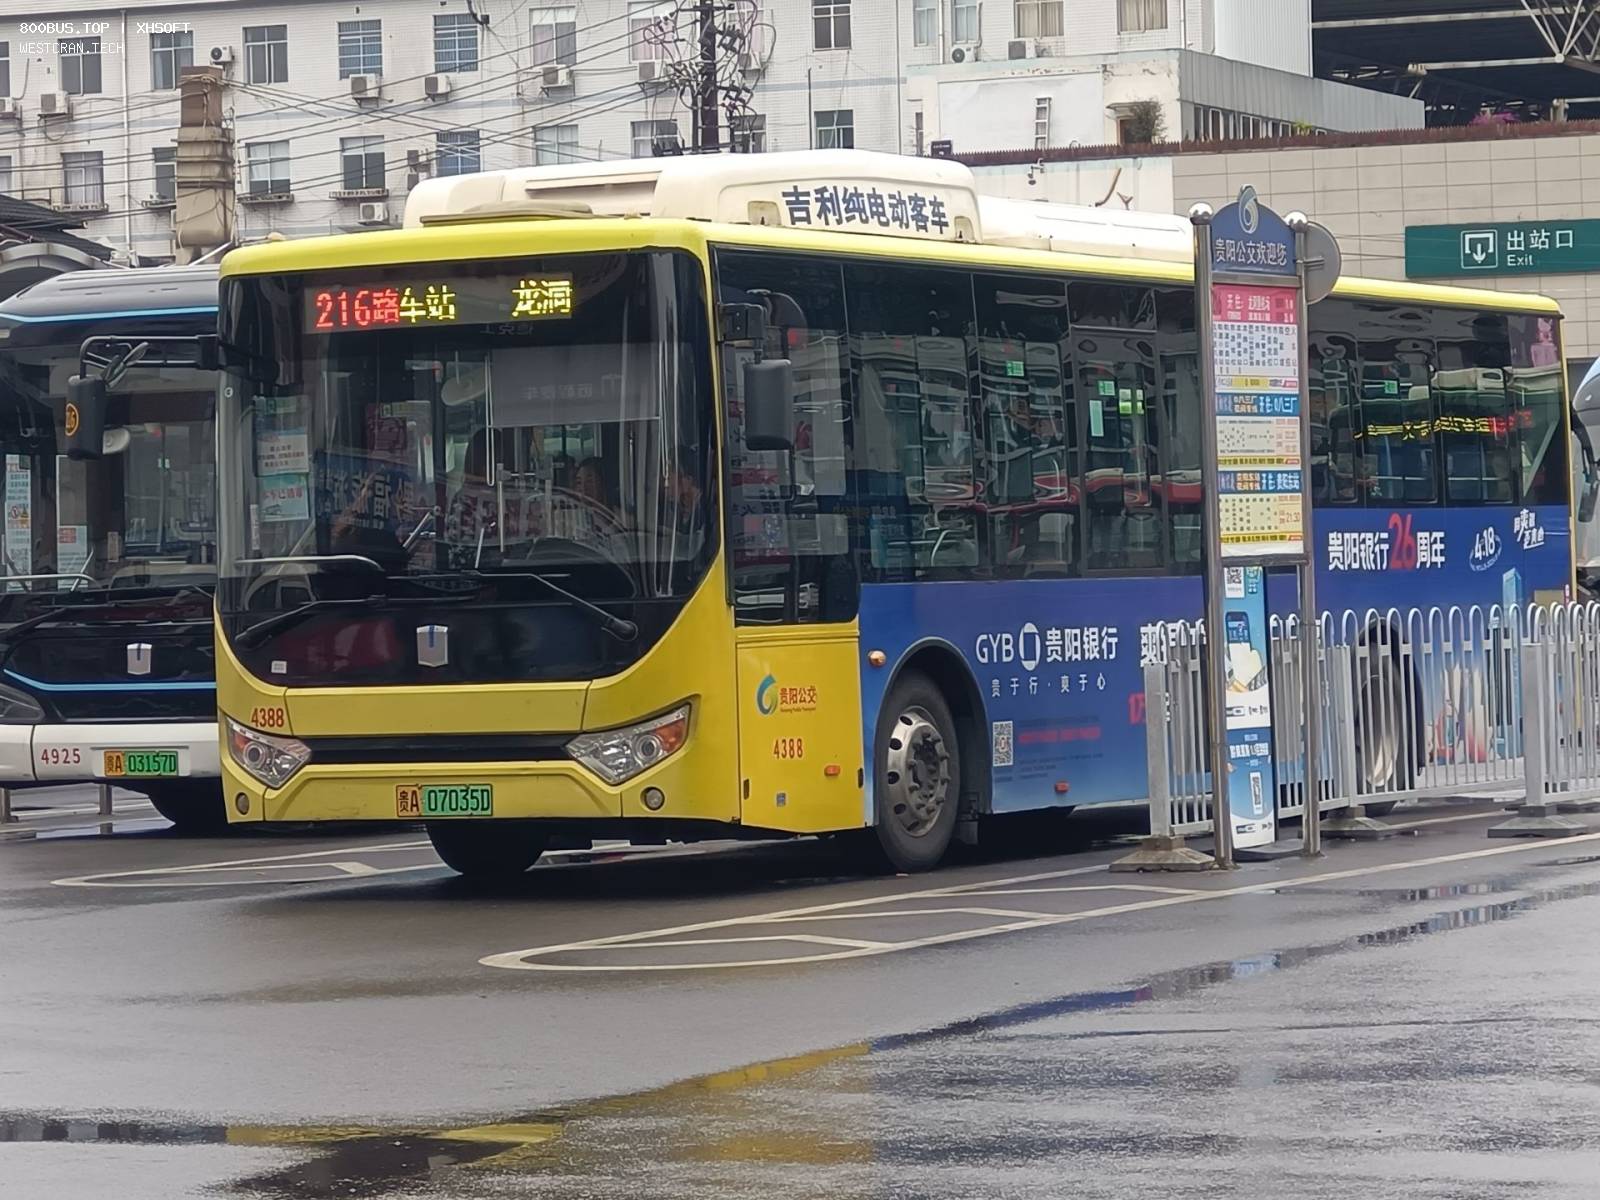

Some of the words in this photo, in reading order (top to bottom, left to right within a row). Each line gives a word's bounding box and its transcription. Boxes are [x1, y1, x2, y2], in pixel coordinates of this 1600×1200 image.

[781, 185, 949, 235] 吉利纯电动客车
[1506, 228, 1574, 251] 出站口
[1506, 254, 1534, 266] Exit
[511, 279, 573, 318] 龙洞
[975, 633, 1015, 664] GYB
[1045, 626, 1119, 663] 贵阳银行
[779, 685, 817, 705] 贵阳公交
[251, 703, 285, 728] 4388
[41, 748, 81, 765] 4925
[773, 738, 804, 759] 4388
